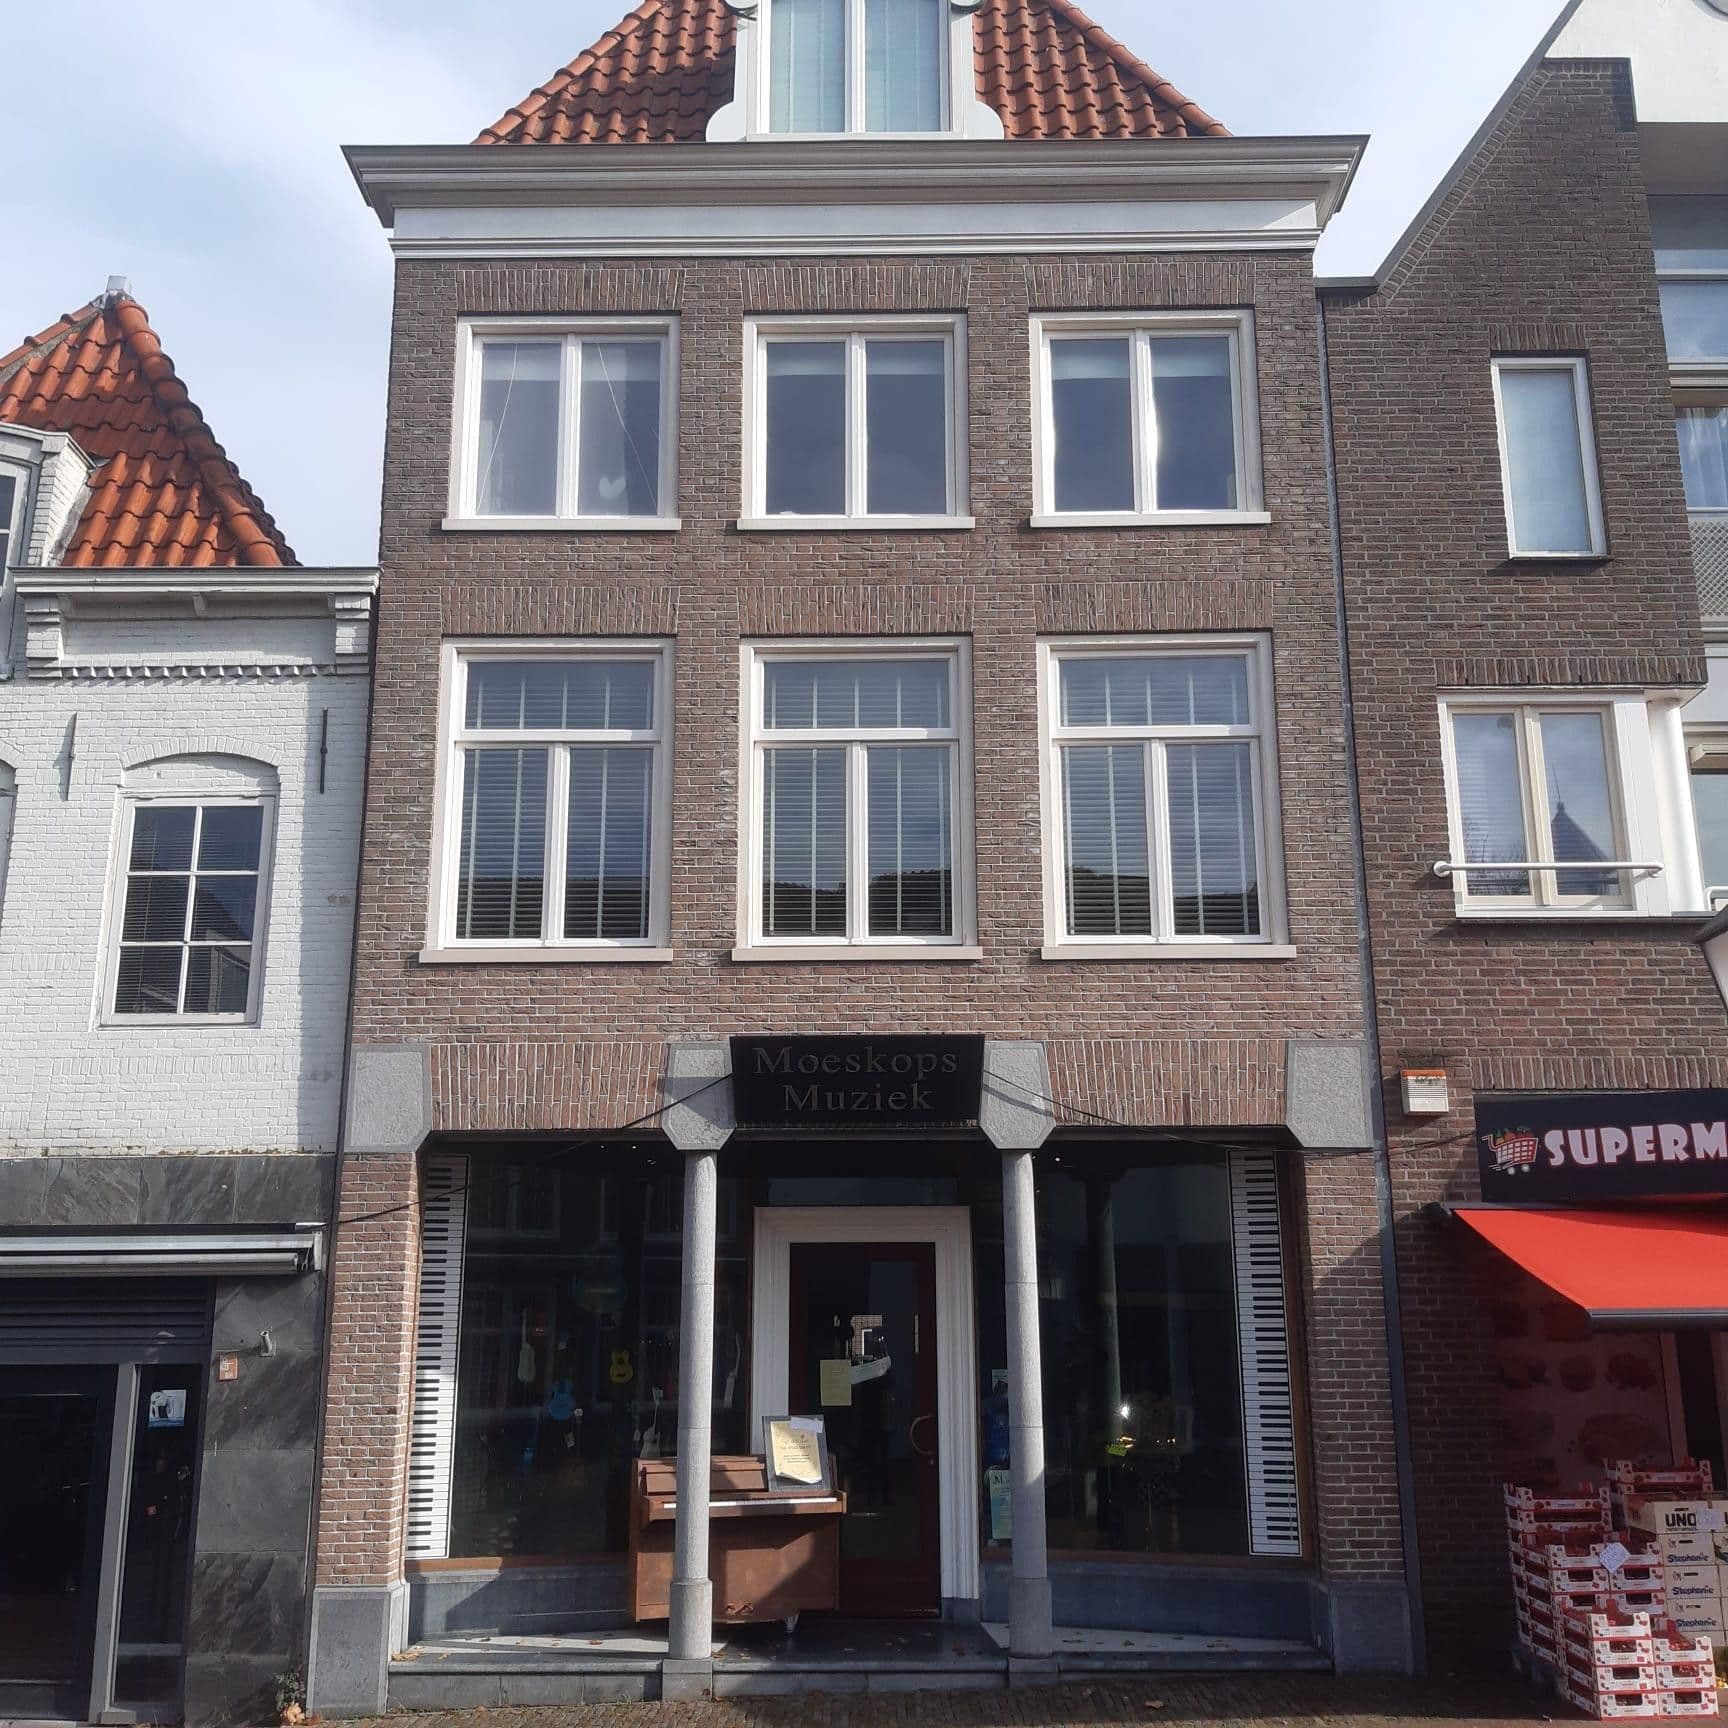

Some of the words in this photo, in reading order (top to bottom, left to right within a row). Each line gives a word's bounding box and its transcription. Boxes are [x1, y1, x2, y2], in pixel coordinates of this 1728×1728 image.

[752, 1046, 958, 1080] Moeskops
[783, 1083, 935, 1111] Muziek
[1544, 1121, 1728, 1167] SUPERM
[1667, 1553, 1709, 1564] Stephanie
[1672, 1585, 1714, 1596] Stephanie
